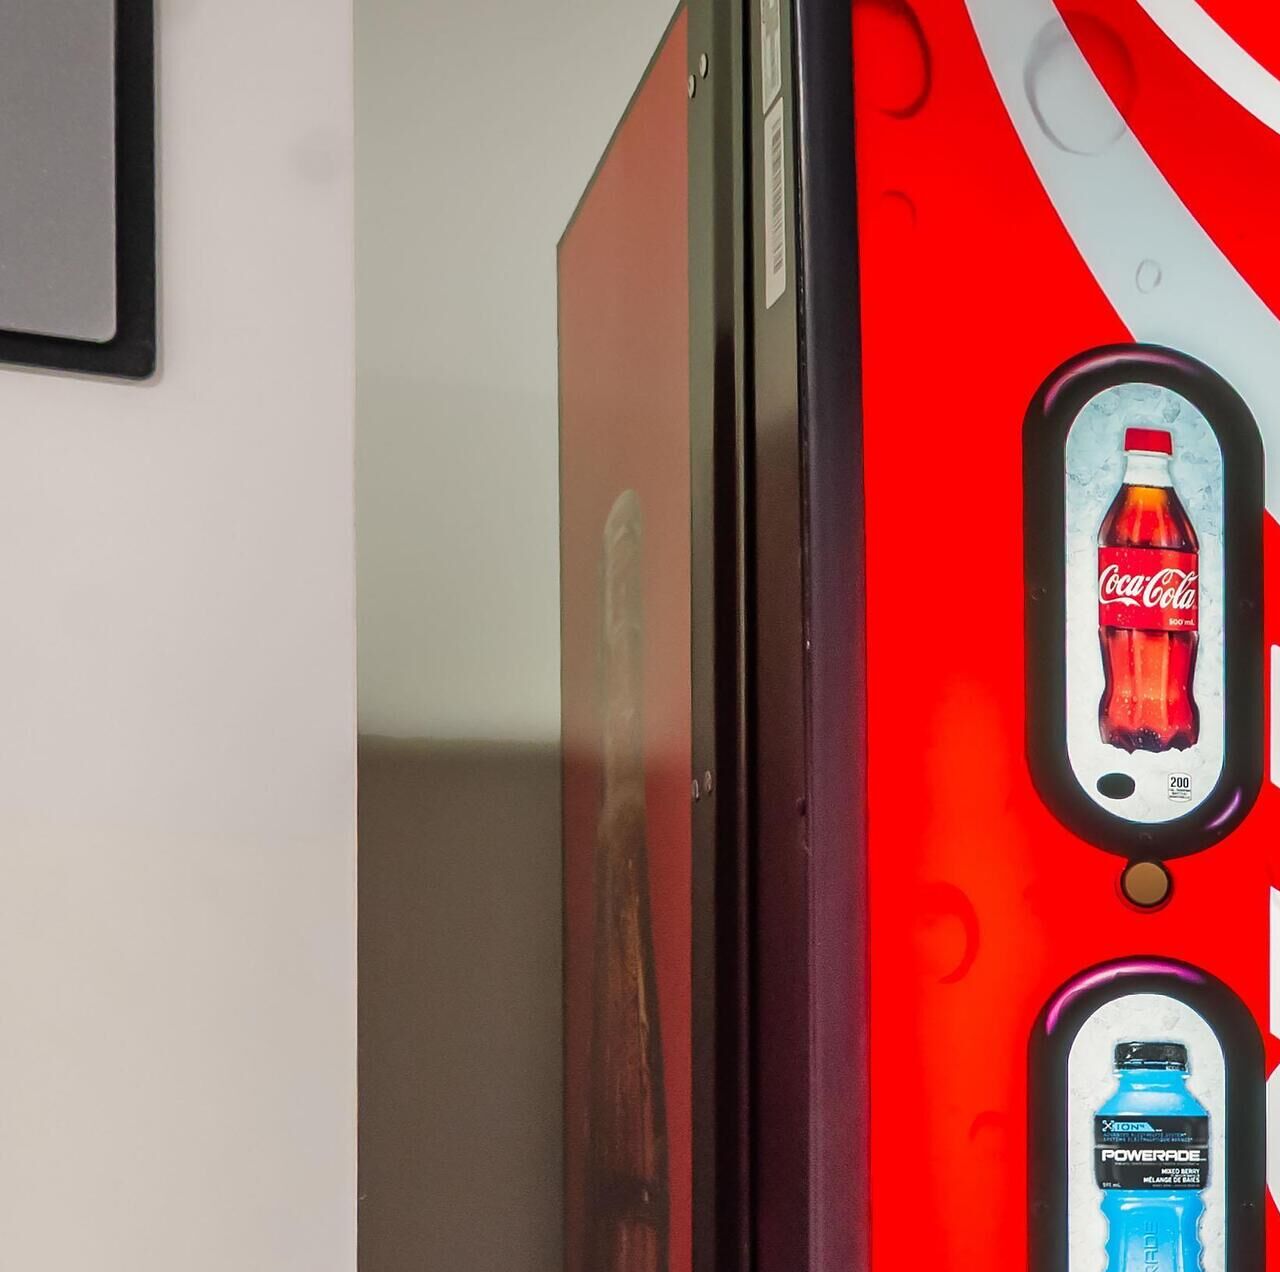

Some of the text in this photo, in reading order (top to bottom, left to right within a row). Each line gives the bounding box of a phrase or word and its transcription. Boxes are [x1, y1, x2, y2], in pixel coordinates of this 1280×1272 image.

[1099, 564, 1199, 609] Coca-Cola
[1170, 776, 1189, 788] 200
[1101, 1148, 1201, 1162] POWERADE
